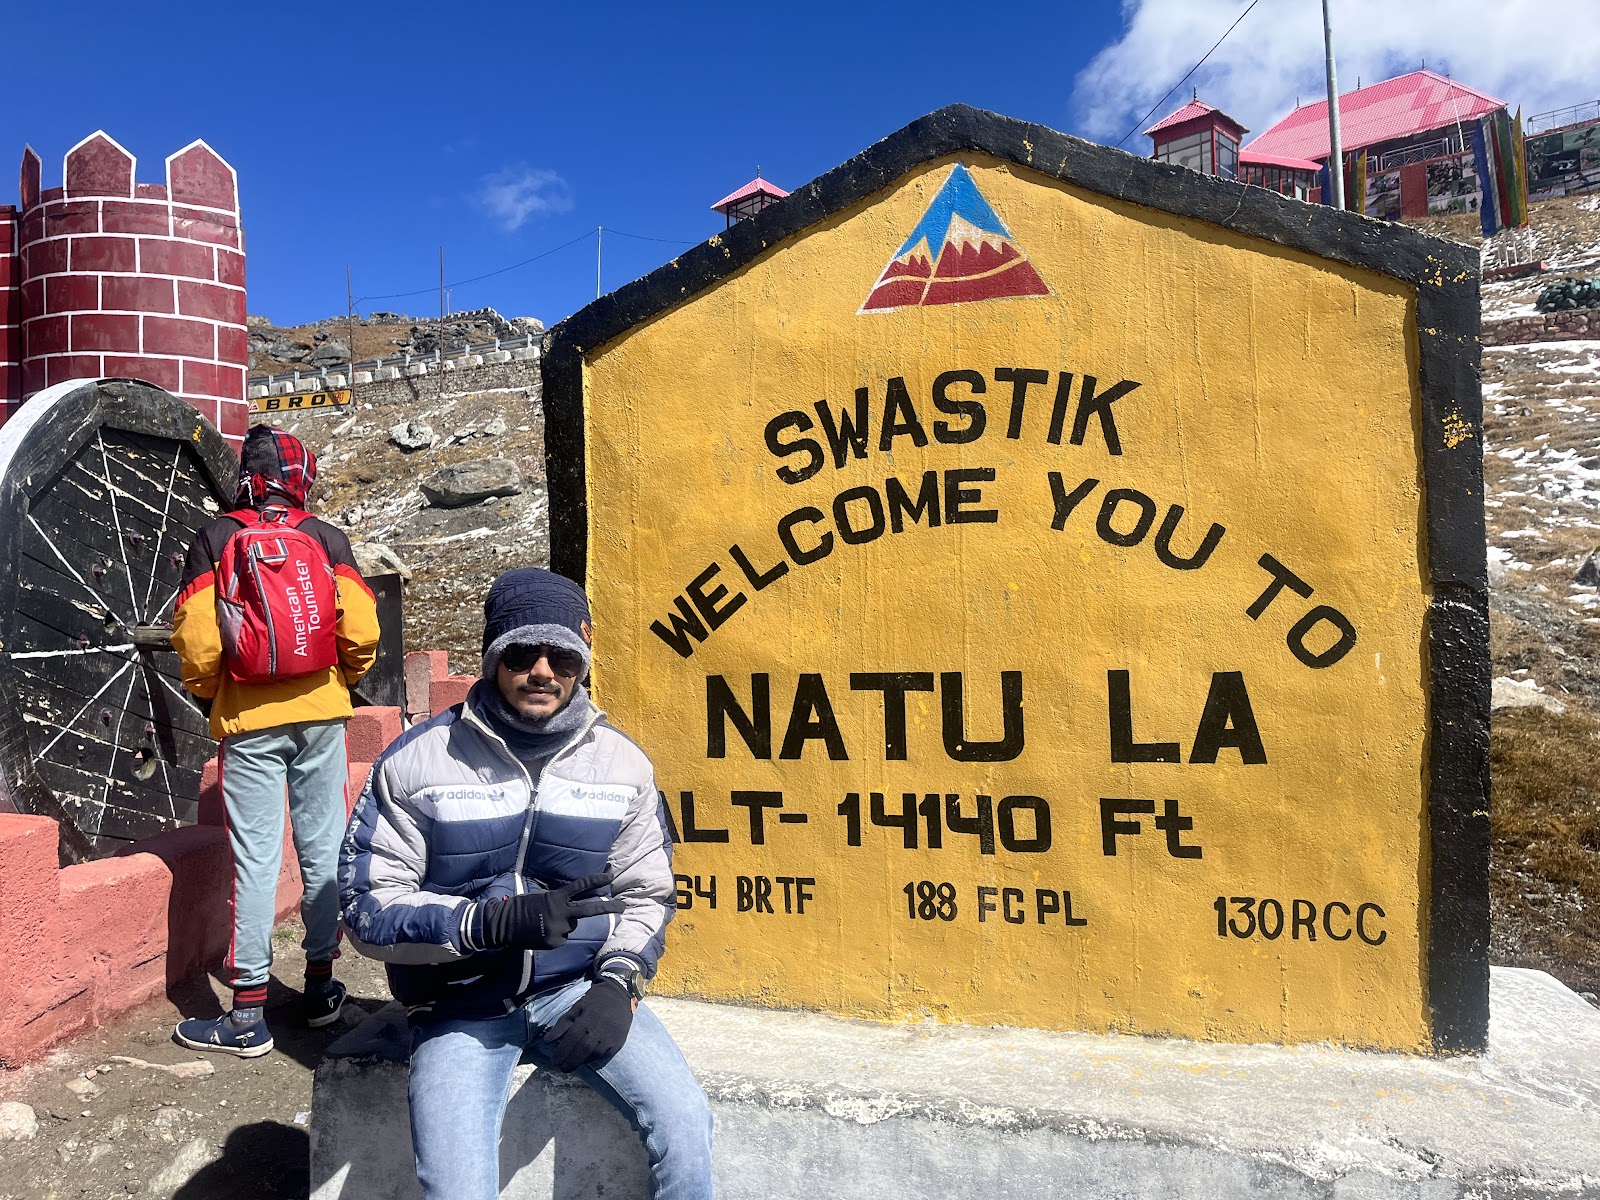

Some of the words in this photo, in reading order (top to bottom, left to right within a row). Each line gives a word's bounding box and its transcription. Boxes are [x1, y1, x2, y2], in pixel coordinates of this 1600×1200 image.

[266, 394, 326, 411] BRO
[765, 368, 1142, 484] SWASTIK
[650, 467, 998, 658] WELCOME
[1048, 472, 1225, 570] YOU
[1246, 553, 1356, 668] TO
[286, 586, 308, 657] American
[706, 671, 1024, 762] NATU
[1108, 670, 1267, 764] LA
[446, 788, 487, 801] adidas
[587, 791, 626, 804] adidas
[838, 793, 1051, 855] 14140
[1100, 798, 1202, 859] Ft
[737, 876, 815, 914] BRTF
[903, 881, 957, 921] 188
